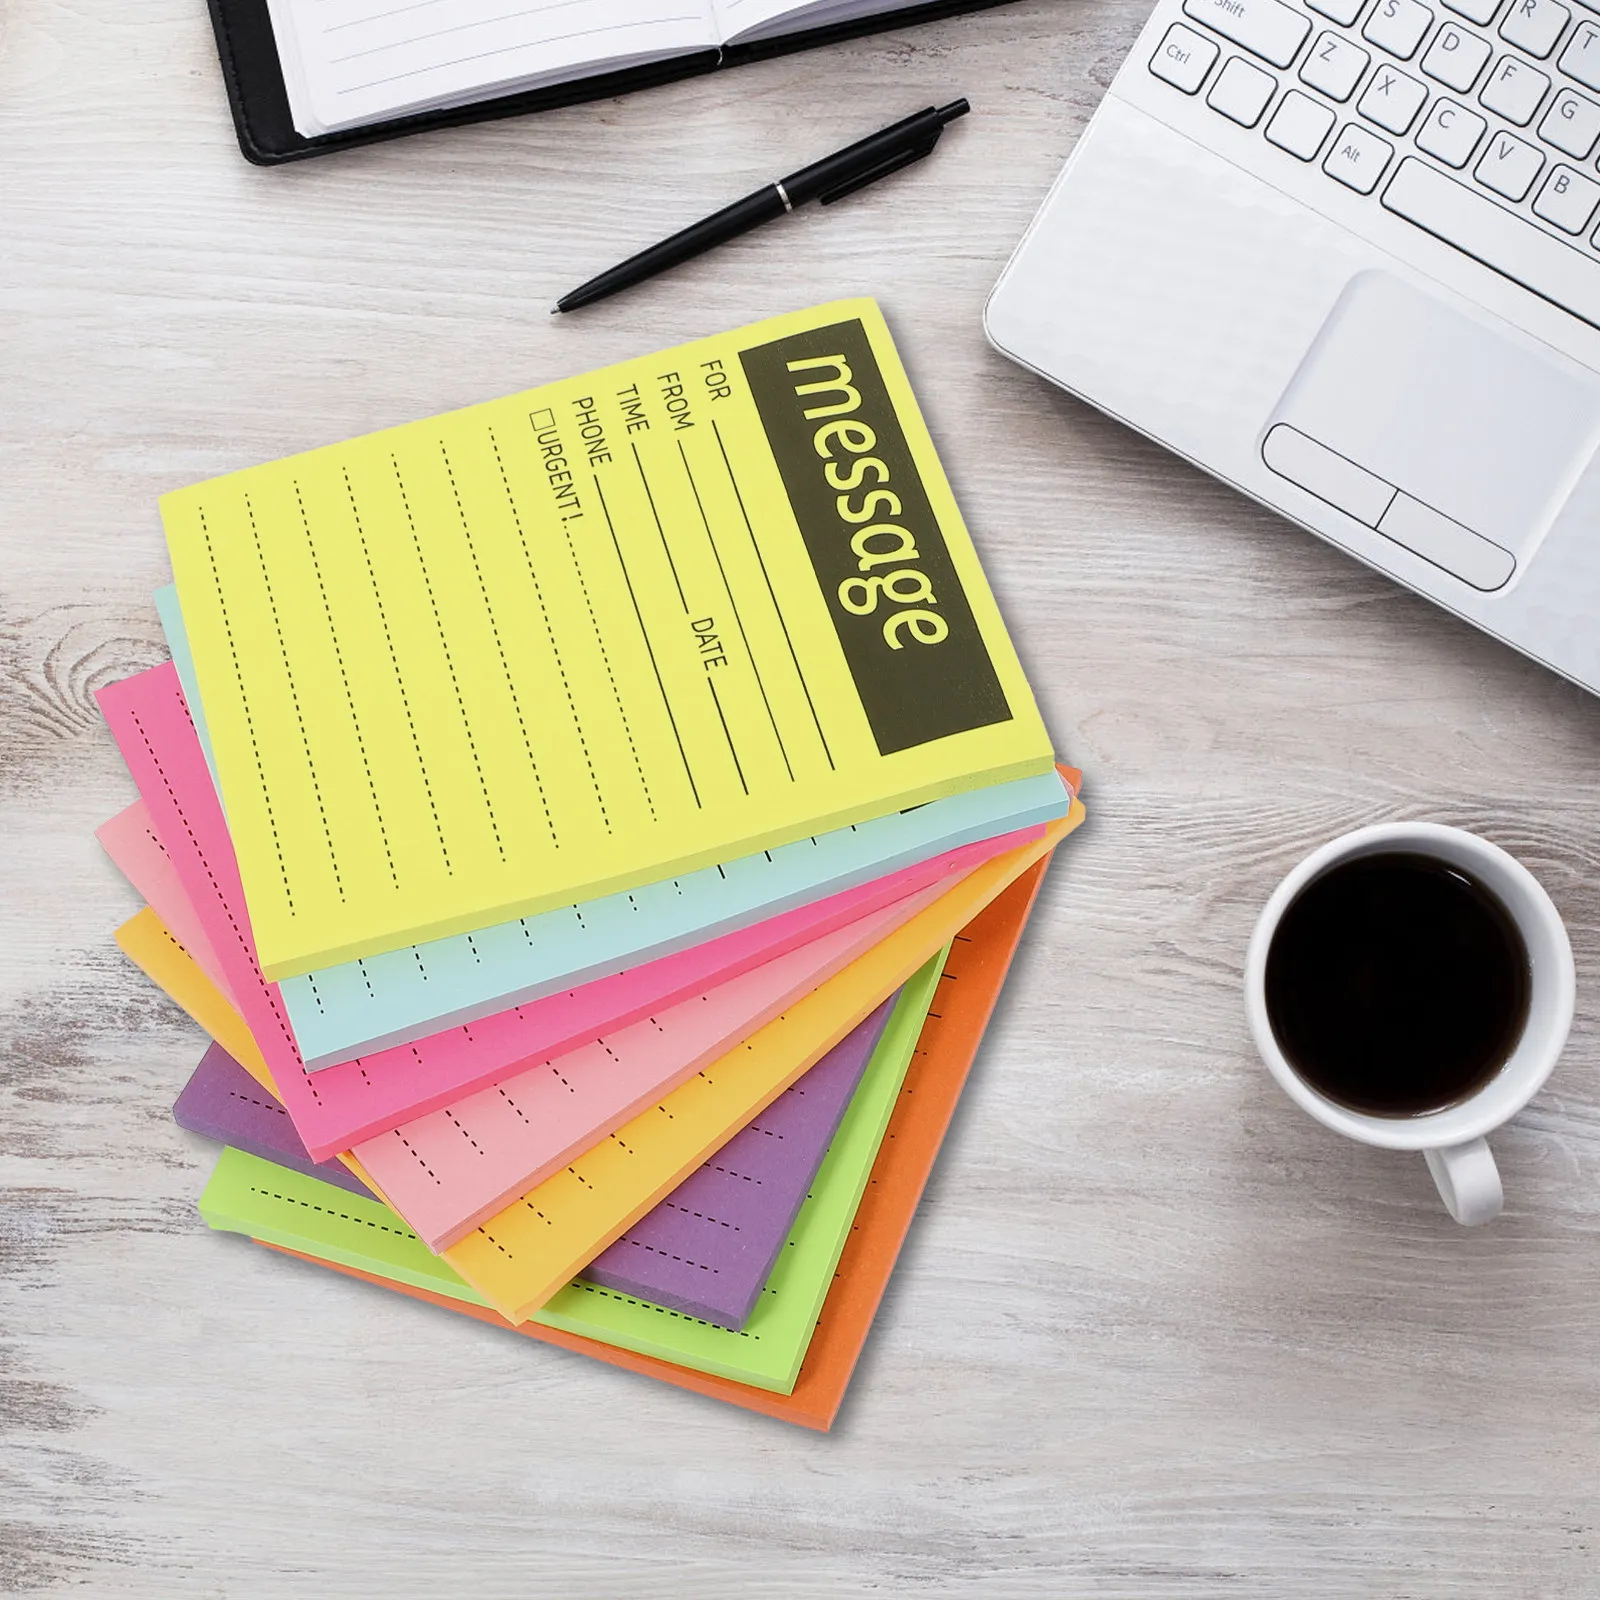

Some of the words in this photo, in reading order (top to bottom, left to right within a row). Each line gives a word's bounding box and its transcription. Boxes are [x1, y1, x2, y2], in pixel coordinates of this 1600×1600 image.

[1384, 0, 1400, 18] S
[1520, 0, 1537, 18] R
[1442, 32, 1460, 51] D
[1583, 30, 1598, 49] T
[1166, 44, 1191, 64] Ctrl
[1319, 41, 1337, 62] Z
[1500, 64, 1517, 82] F
[1377, 75, 1396, 96] X
[1438, 109, 1456, 129] C
[1561, 100, 1579, 119] G
[1341, 144, 1361, 163] Alt
[1498, 141, 1515, 161] V
[1553, 175, 1570, 194] B
[700, 359, 732, 401] FOR
[656, 371, 695, 431] FROM
[572, 397, 613, 467] PHONE
[536, 431, 583, 521] URGENT!
[786, 353, 949, 650] message
[616, 383, 650, 435] TIME
[690, 617, 728, 670] DATE
